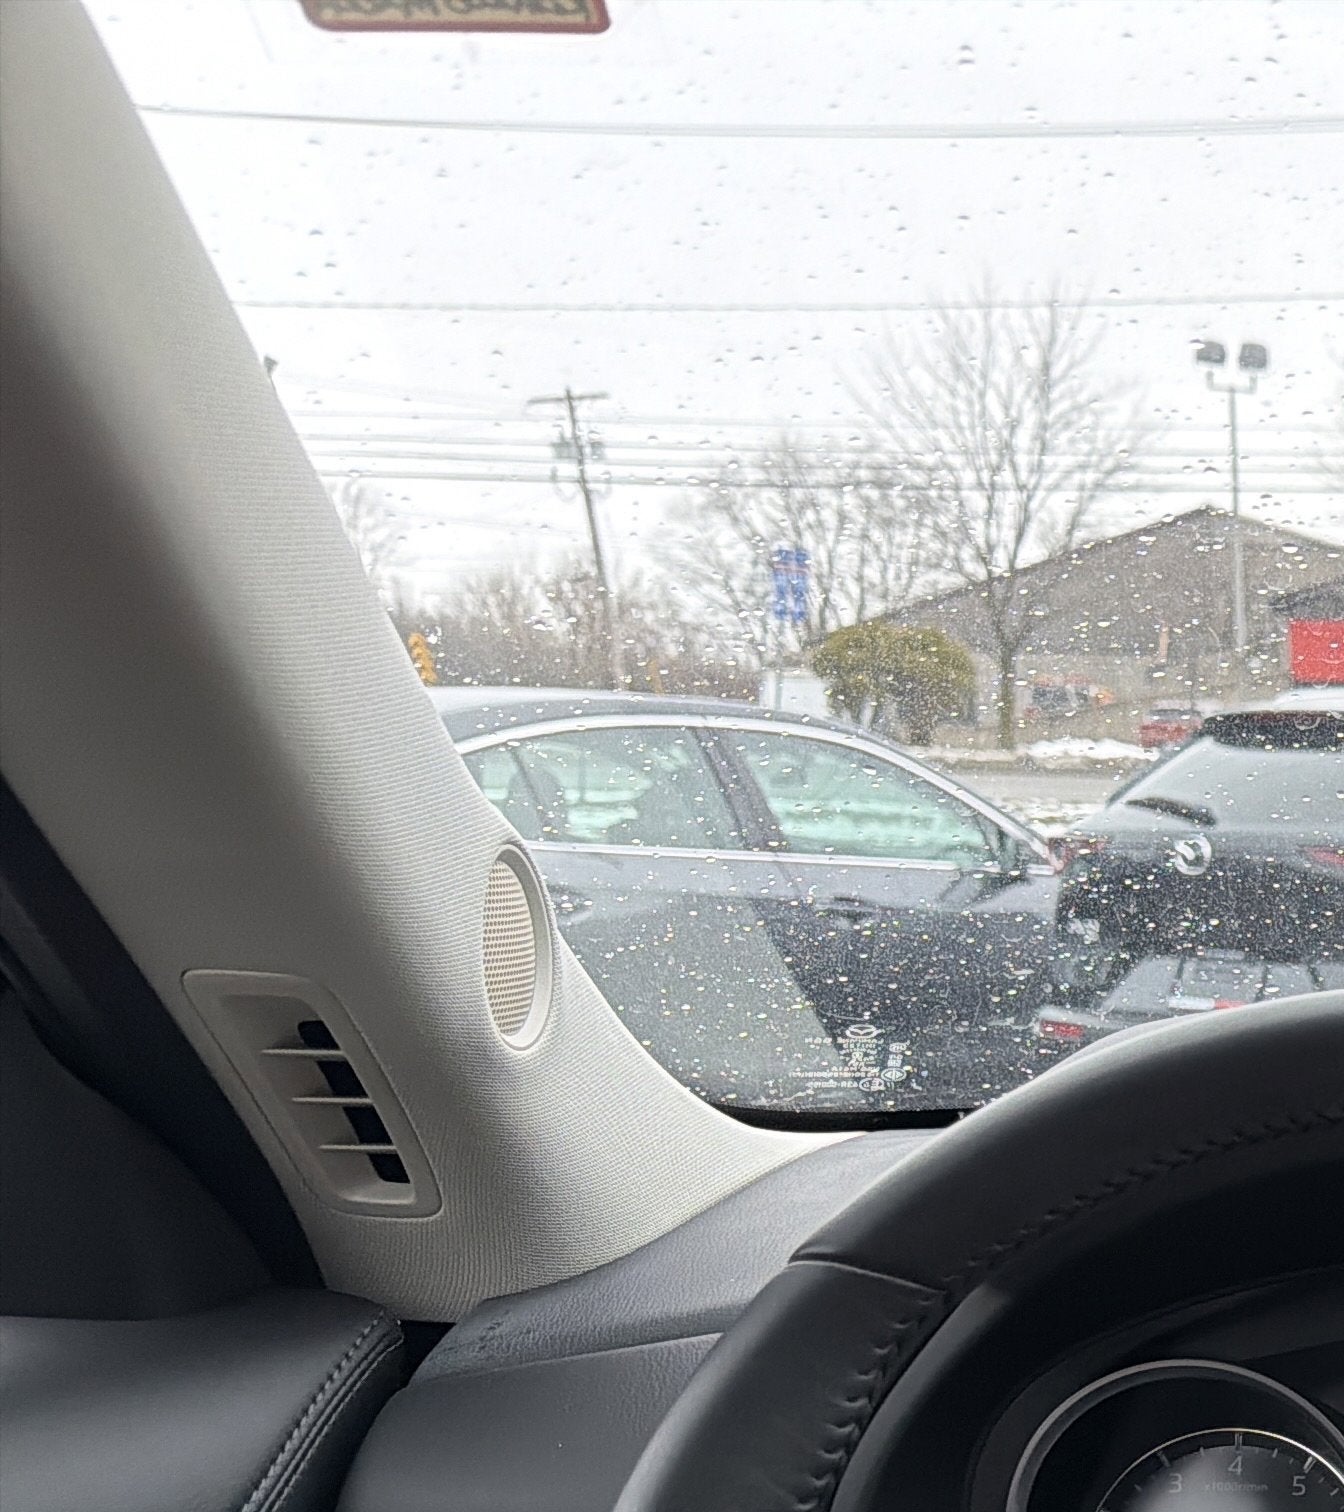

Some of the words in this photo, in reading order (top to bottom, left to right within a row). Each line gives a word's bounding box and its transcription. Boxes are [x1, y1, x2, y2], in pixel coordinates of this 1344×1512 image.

[1227, 1455, 1242, 1475] 4
[1168, 1473, 1183, 1493] 3
[1291, 1475, 1306, 1496] 5
